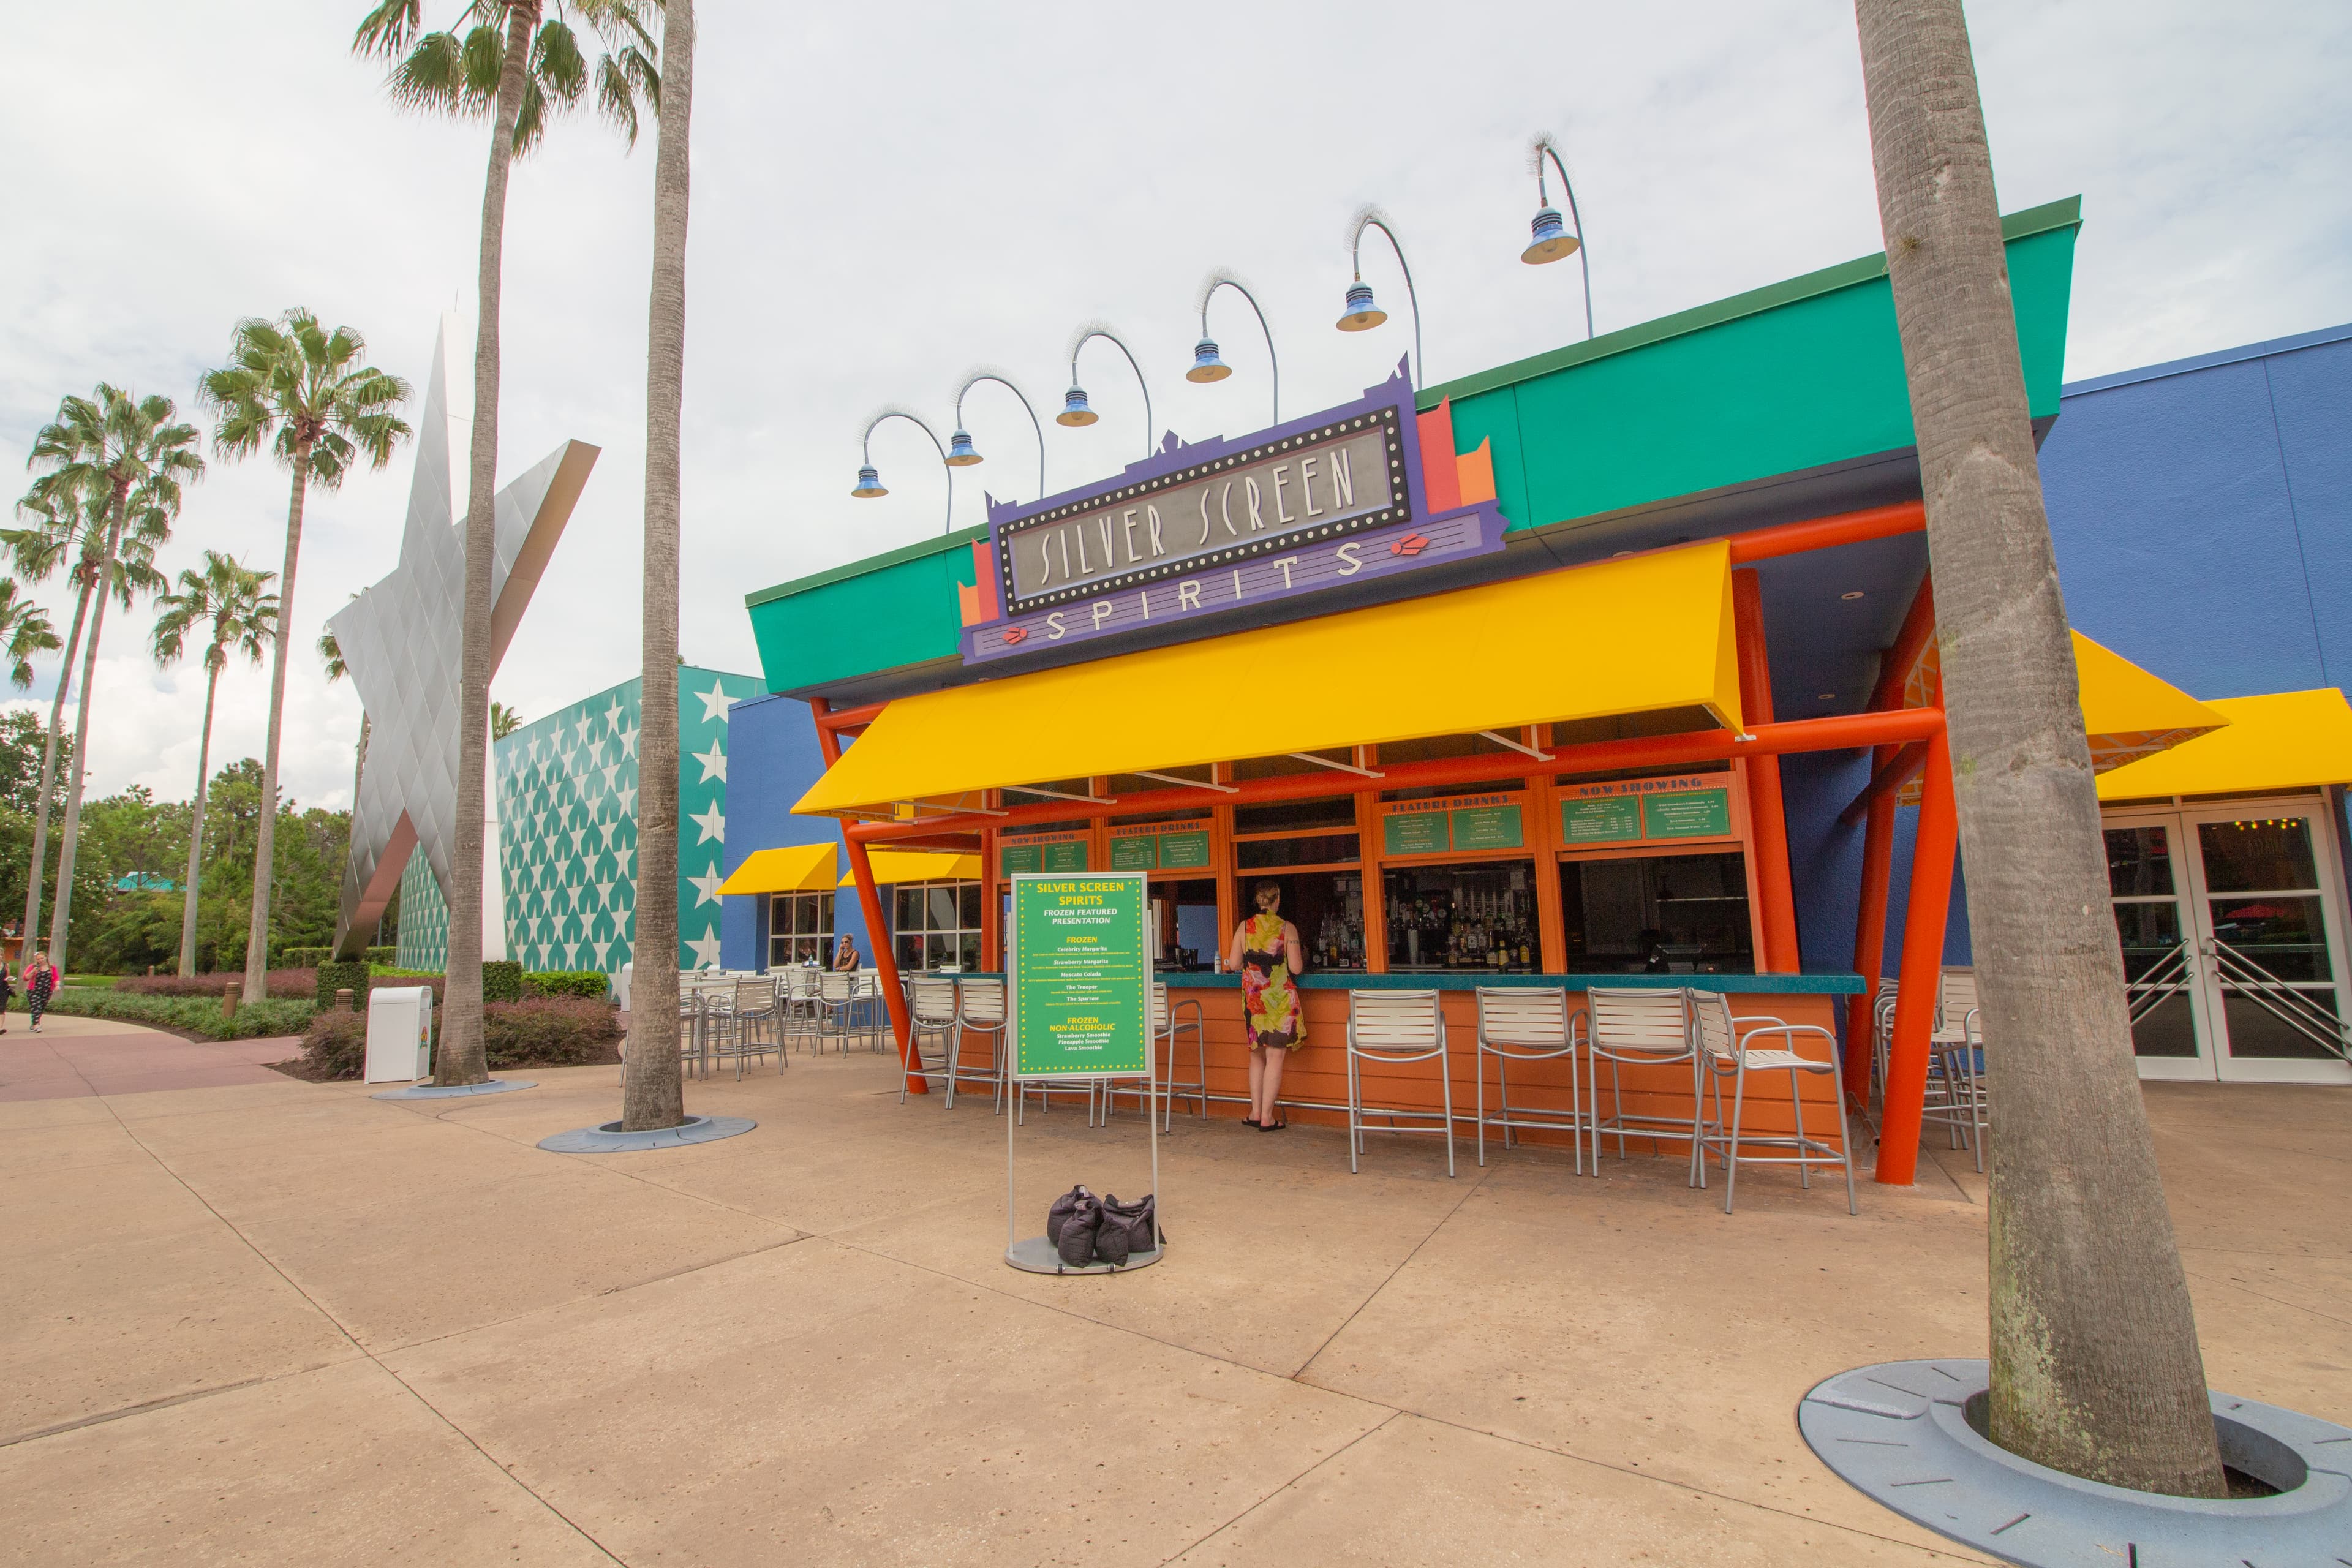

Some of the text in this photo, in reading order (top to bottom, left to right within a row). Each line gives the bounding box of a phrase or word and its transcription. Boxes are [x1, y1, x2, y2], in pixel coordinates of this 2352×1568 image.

[1040, 447, 1355, 586] SILVER SCREEN
[1046, 541, 1364, 641] SPIRITS
[1580, 778, 1702, 796] NOW SHOWING
[1392, 795, 1509, 812] FEATURE DRINKS
[1037, 882, 1125, 893] SILVER SCREEN
[1058, 895, 1104, 905] SPIRITS
